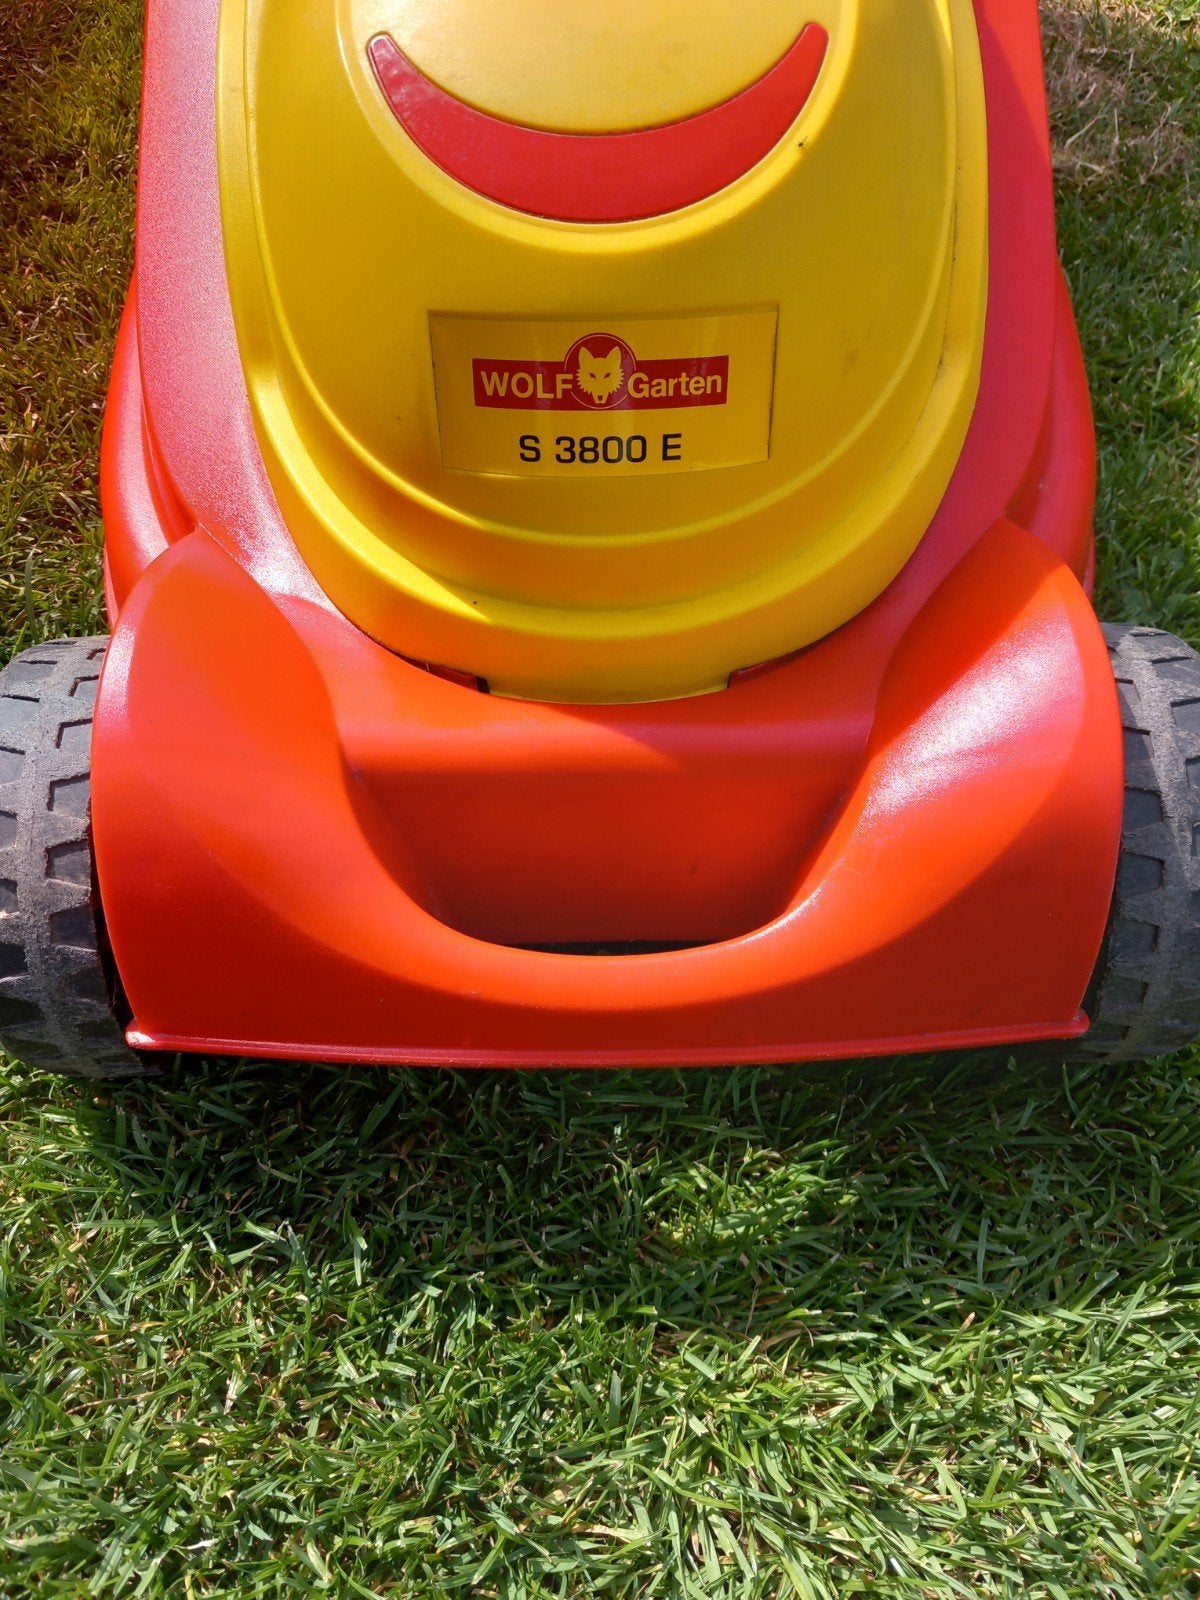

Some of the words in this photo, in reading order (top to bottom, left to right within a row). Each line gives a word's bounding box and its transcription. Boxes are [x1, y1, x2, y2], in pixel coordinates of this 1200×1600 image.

[481, 371, 574, 399] WOLF
[627, 372, 722, 399] Garten
[518, 434, 542, 463] S
[555, 435, 648, 464] 3800
[661, 432, 682, 462] E
